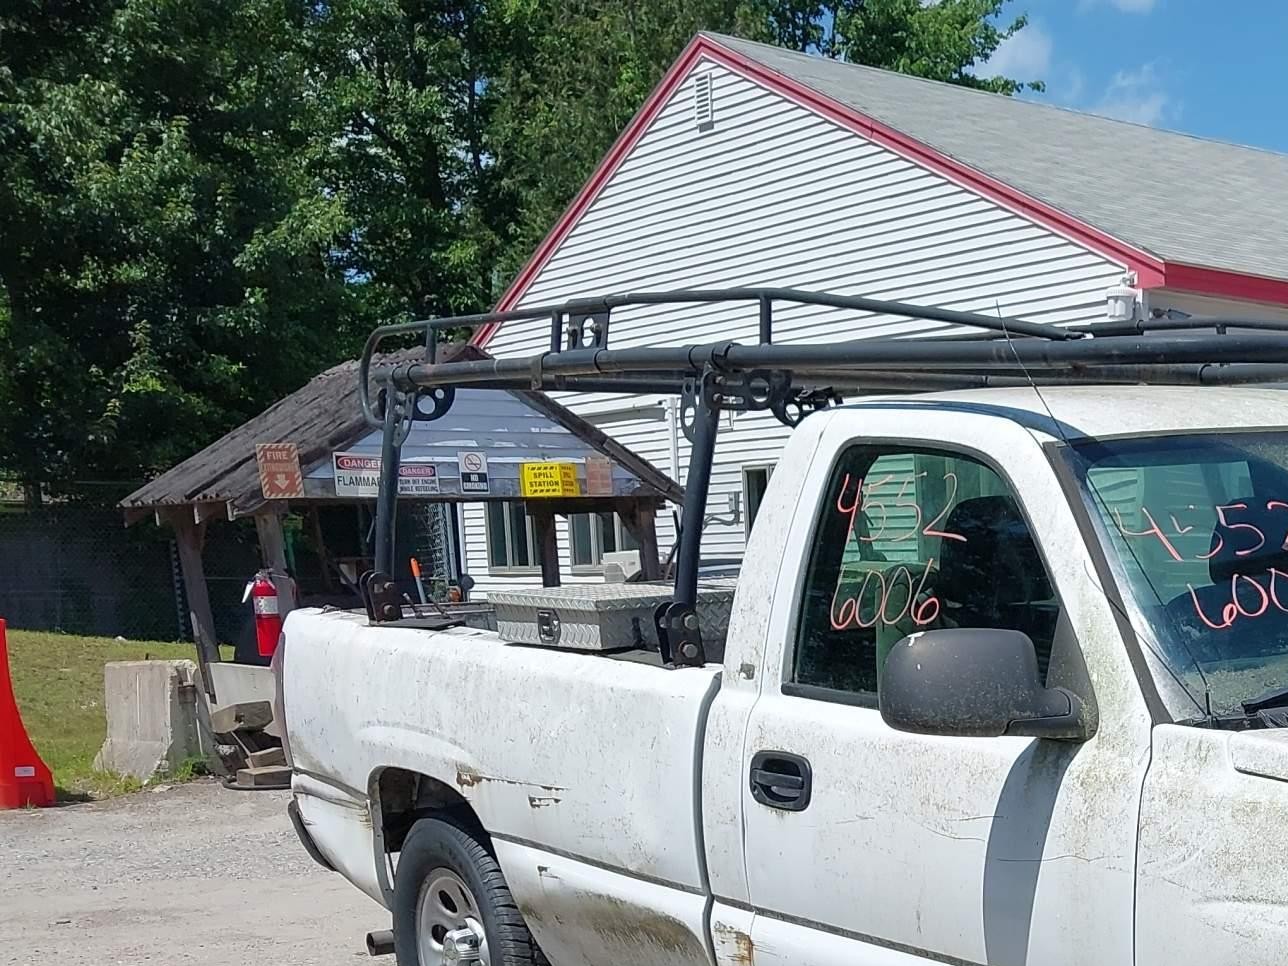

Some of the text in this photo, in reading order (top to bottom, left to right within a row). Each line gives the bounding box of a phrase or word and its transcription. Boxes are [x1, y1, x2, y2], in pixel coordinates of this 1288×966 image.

[266, 450, 289, 460] FIRE
[533, 471, 554, 479] SPILL
[336, 475, 380, 487] FLAMMA
[529, 480, 560, 488] STATION
[837, 472, 968, 552] 4552
[830, 557, 940, 630] 6006
